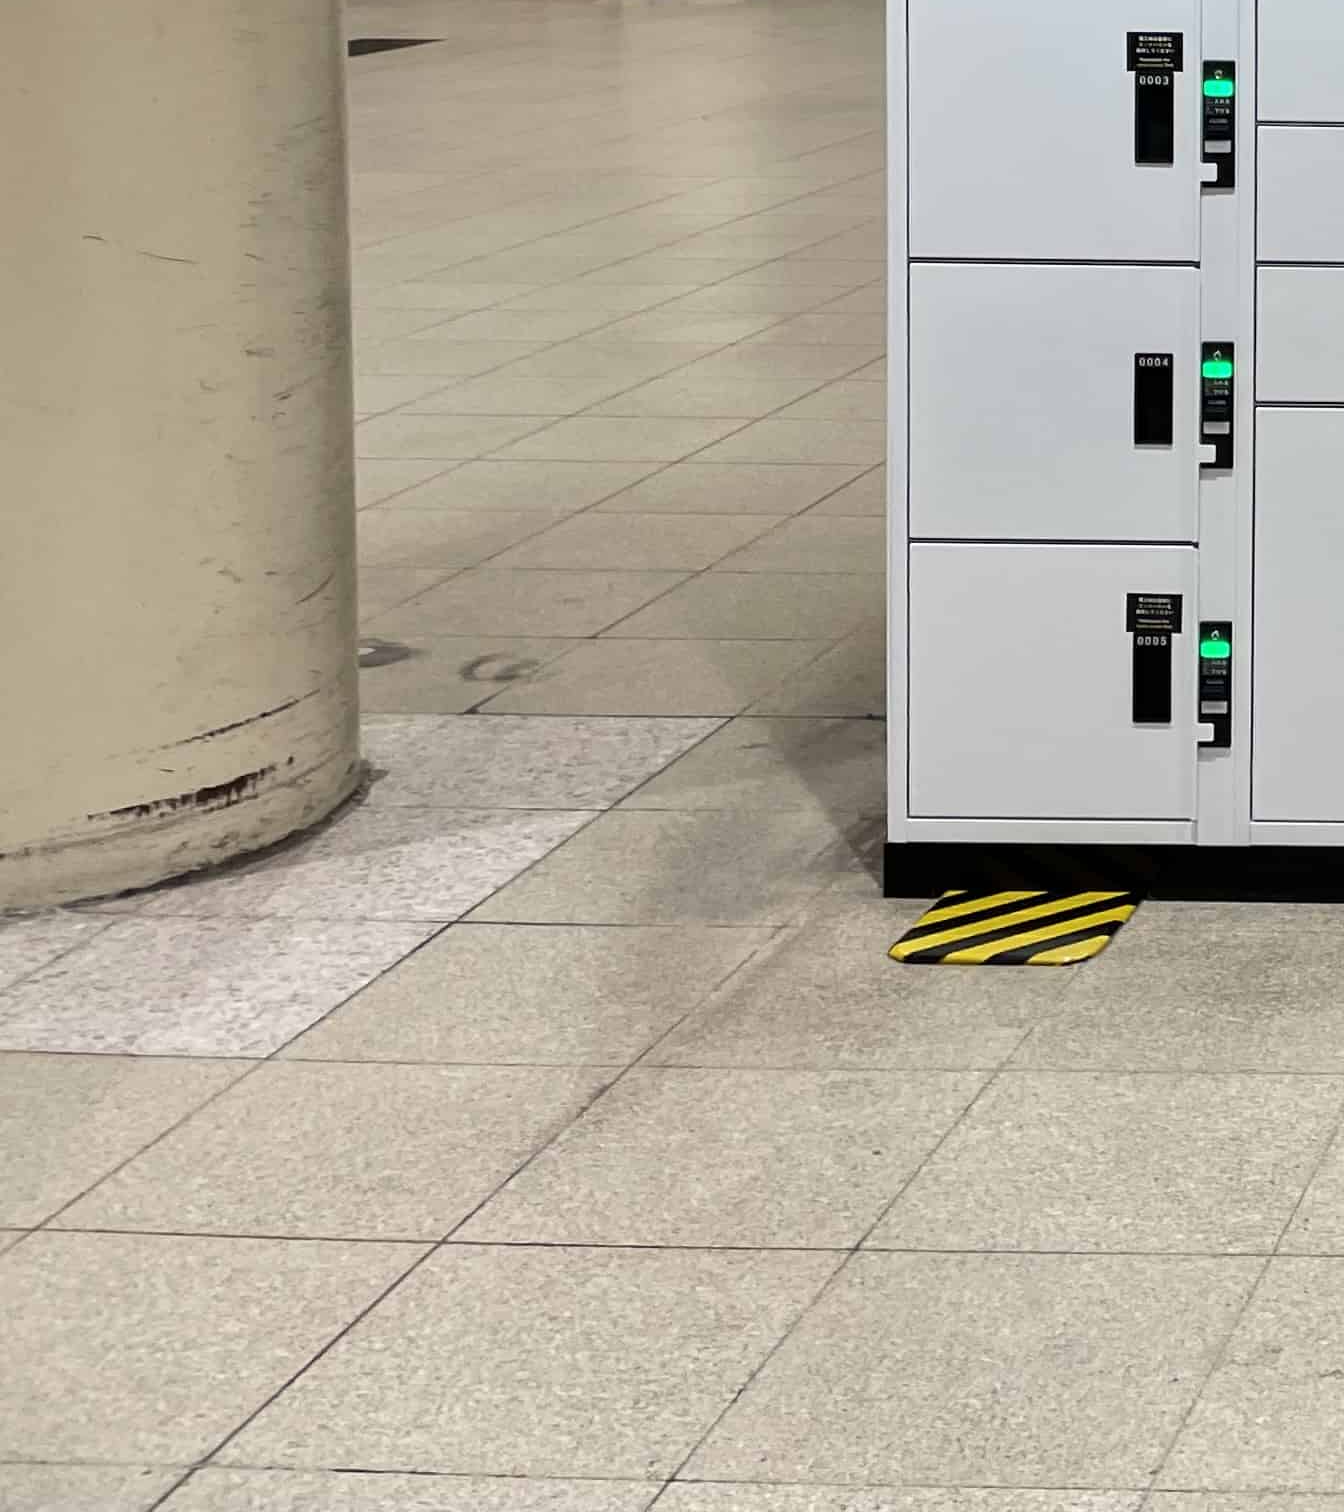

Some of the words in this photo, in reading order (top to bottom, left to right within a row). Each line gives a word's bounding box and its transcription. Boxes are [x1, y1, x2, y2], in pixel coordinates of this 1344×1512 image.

[1140, 75, 1168, 86] 0003
[1139, 356, 1168, 367] 0004
[1137, 635, 1166, 646] 0005
